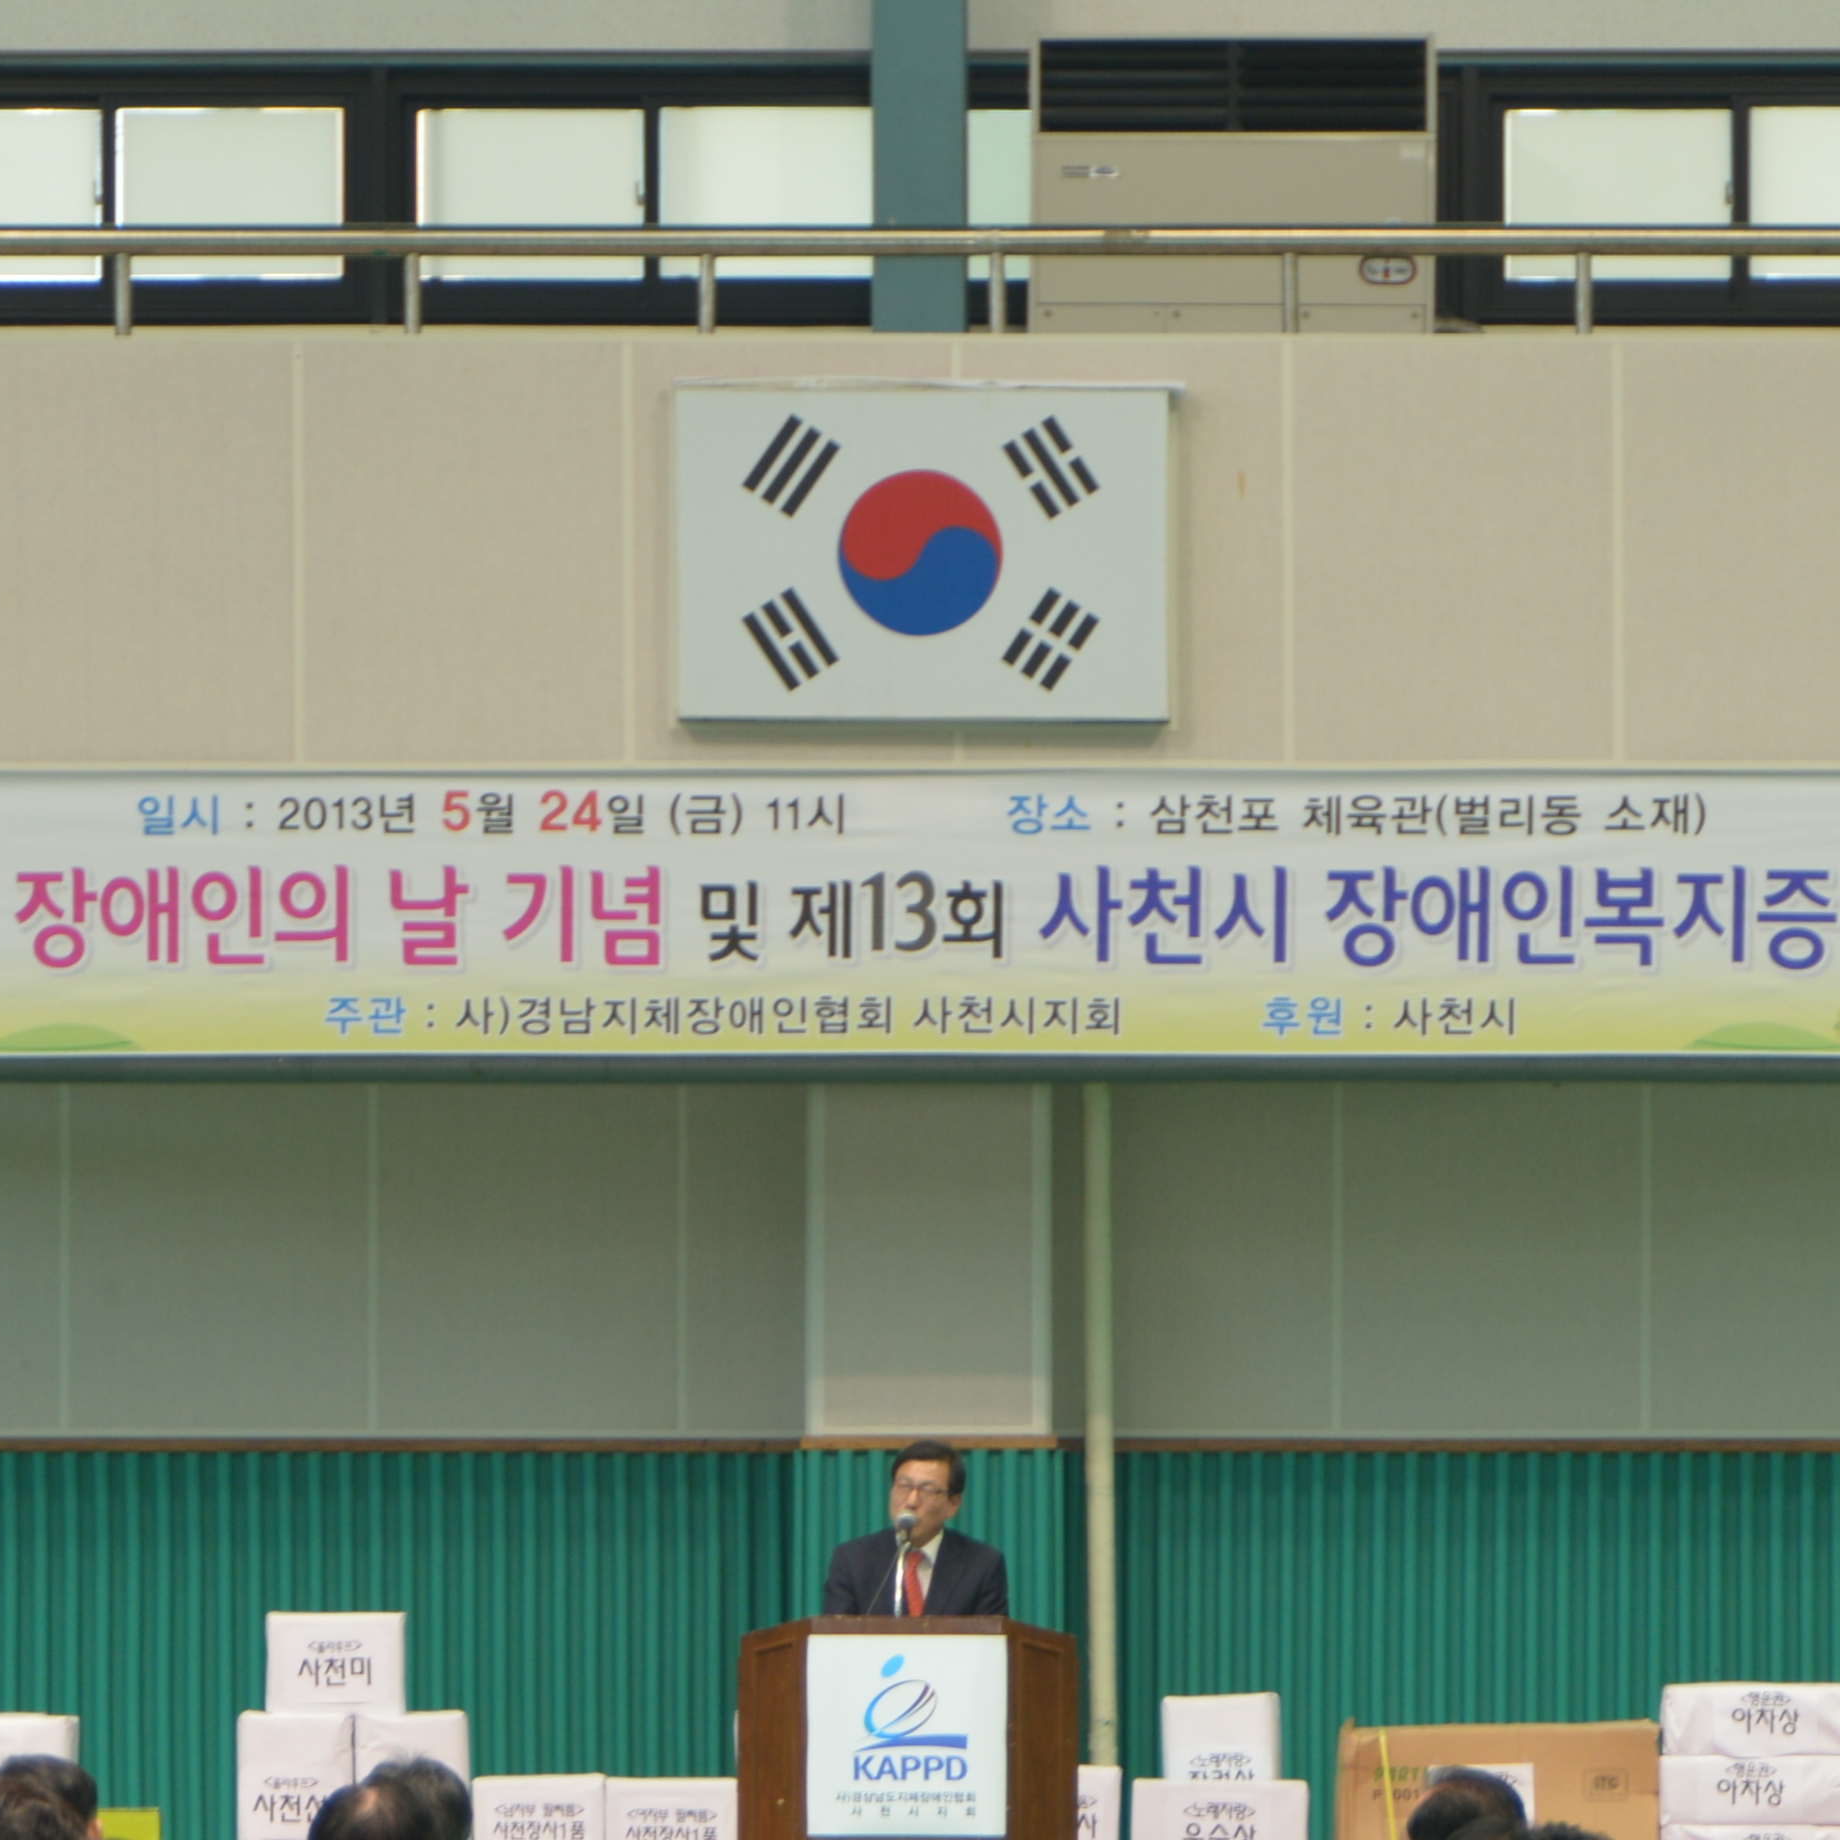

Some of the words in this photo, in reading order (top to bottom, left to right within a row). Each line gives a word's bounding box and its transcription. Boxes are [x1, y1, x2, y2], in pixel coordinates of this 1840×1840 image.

[137, 794, 221, 835] 일시
[278, 793, 417, 835] 2013년
[442, 789, 516, 835] 5월
[540, 790, 646, 835] 24일
[669, 793, 744, 836] (금)
[765, 793, 847, 835] 11시
[1007, 795, 1092, 836] 장소
[1150, 795, 1279, 836] 삼천포
[1604, 793, 1708, 838] 소재)
[14, 864, 351, 970] 장애인의
[387, 866, 471, 968] 날
[501, 865, 663, 968] 기념
[698, 880, 760, 963] 및
[788, 869, 1005, 961] 제13회
[1039, 865, 1288, 966] 사천시
[324, 995, 408, 1036] 주관
[454, 995, 894, 1037] 사)경남지체장애인협회
[913, 995, 1123, 1037] 사천시지회
[1262, 995, 1344, 1036] 후원
[1393, 995, 1517, 1036] 사천시
[297, 1657, 372, 1688] 사천미
[1731, 1708, 1800, 1736] 아자상
[853, 1755, 968, 1781] KAPPD
[1716, 1779, 1786, 1807] 아자상
